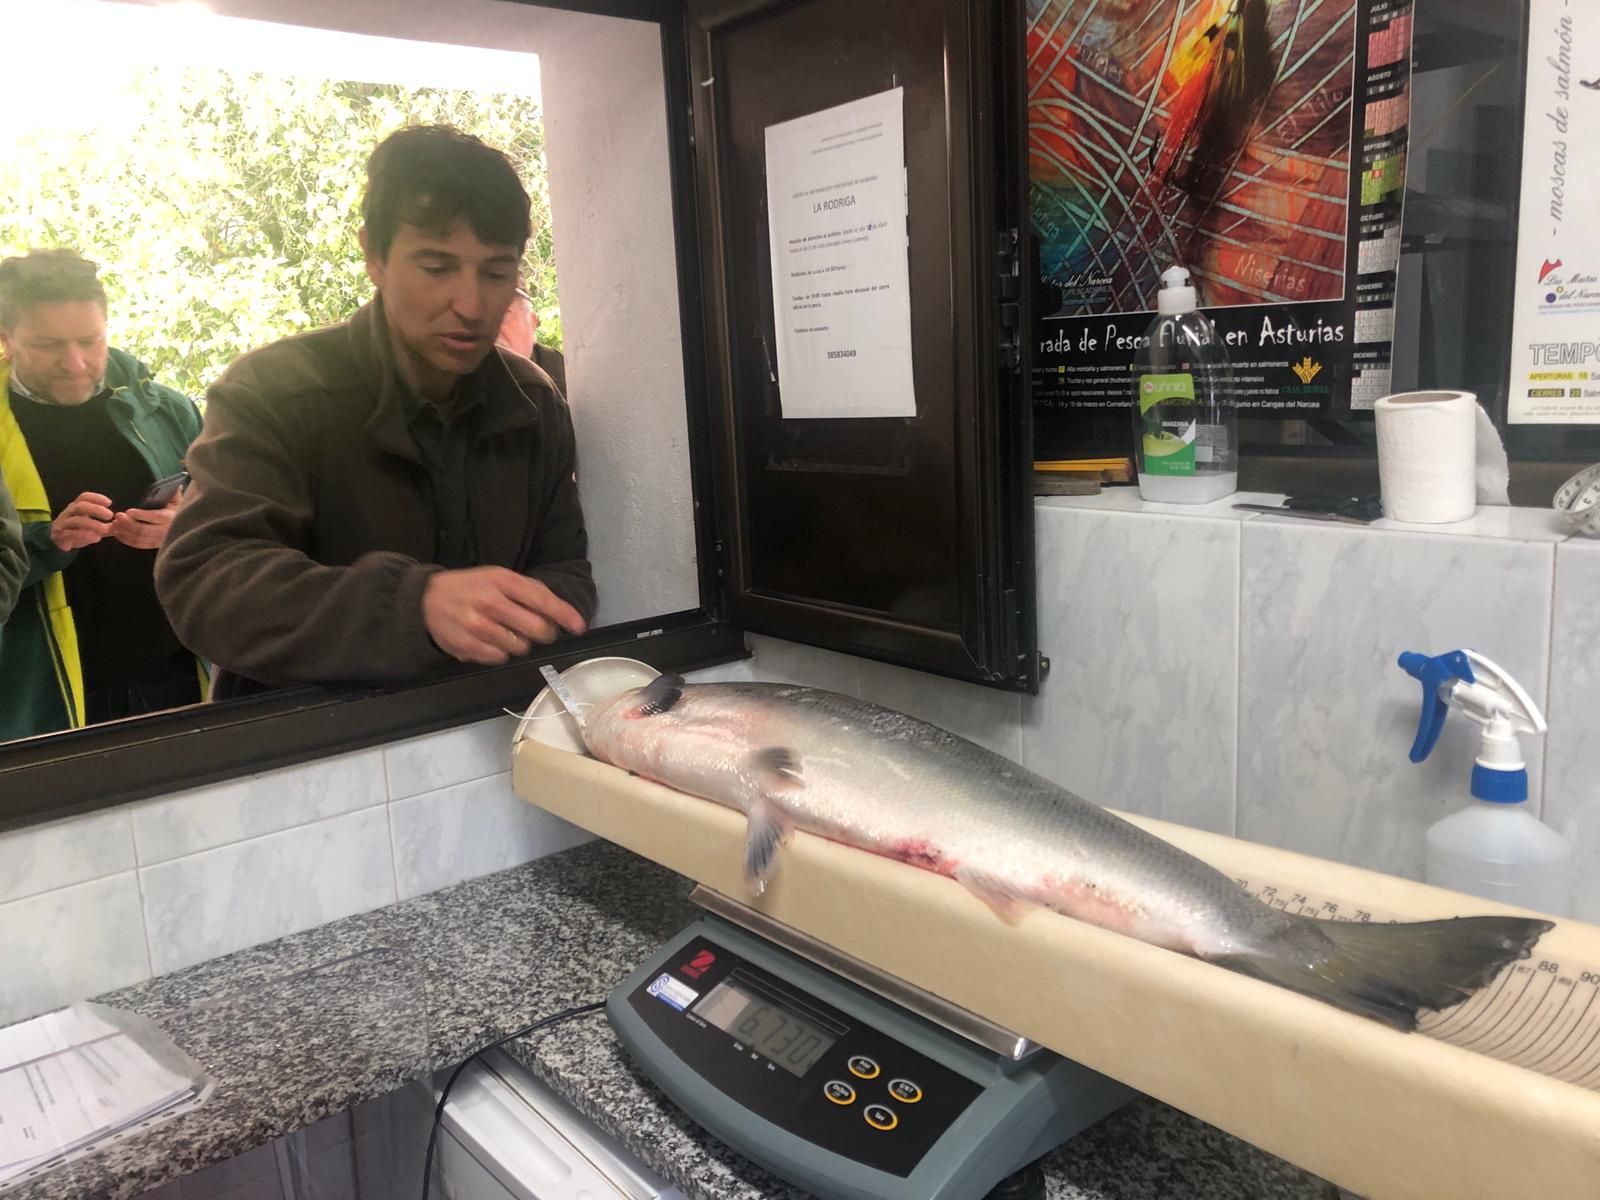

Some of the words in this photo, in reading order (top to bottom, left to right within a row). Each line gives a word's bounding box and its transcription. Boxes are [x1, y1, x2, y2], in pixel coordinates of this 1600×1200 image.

[1546, 15, 1572, 101] salmón
[1367, 71, 1392, 82] AGOSTO
[1546, 107, 1569, 133] de
[1550, 140, 1567, 221] moscas
[813, 203, 822, 213] LA
[823, 195, 856, 210] RODRIGA
[1079, 327, 1097, 354] de
[1104, 324, 1151, 352] Pesca
[1225, 330, 1248, 346] en
[1259, 315, 1344, 346] Asturias
[1529, 342, 1600, 366] TEMP
[1529, 373, 1574, 381] APERTURAS
[1261, 400, 1285, 409] Cangas
[1297, 400, 1320, 408] Narcea
[1263, 886, 1278, 896] 72
[1292, 894, 1307, 904] 74
[1322, 903, 1338, 913] 76
[1355, 911, 1371, 922] 78
[1538, 960, 1559, 974] 88
[1580, 971, 1600, 985] 90
